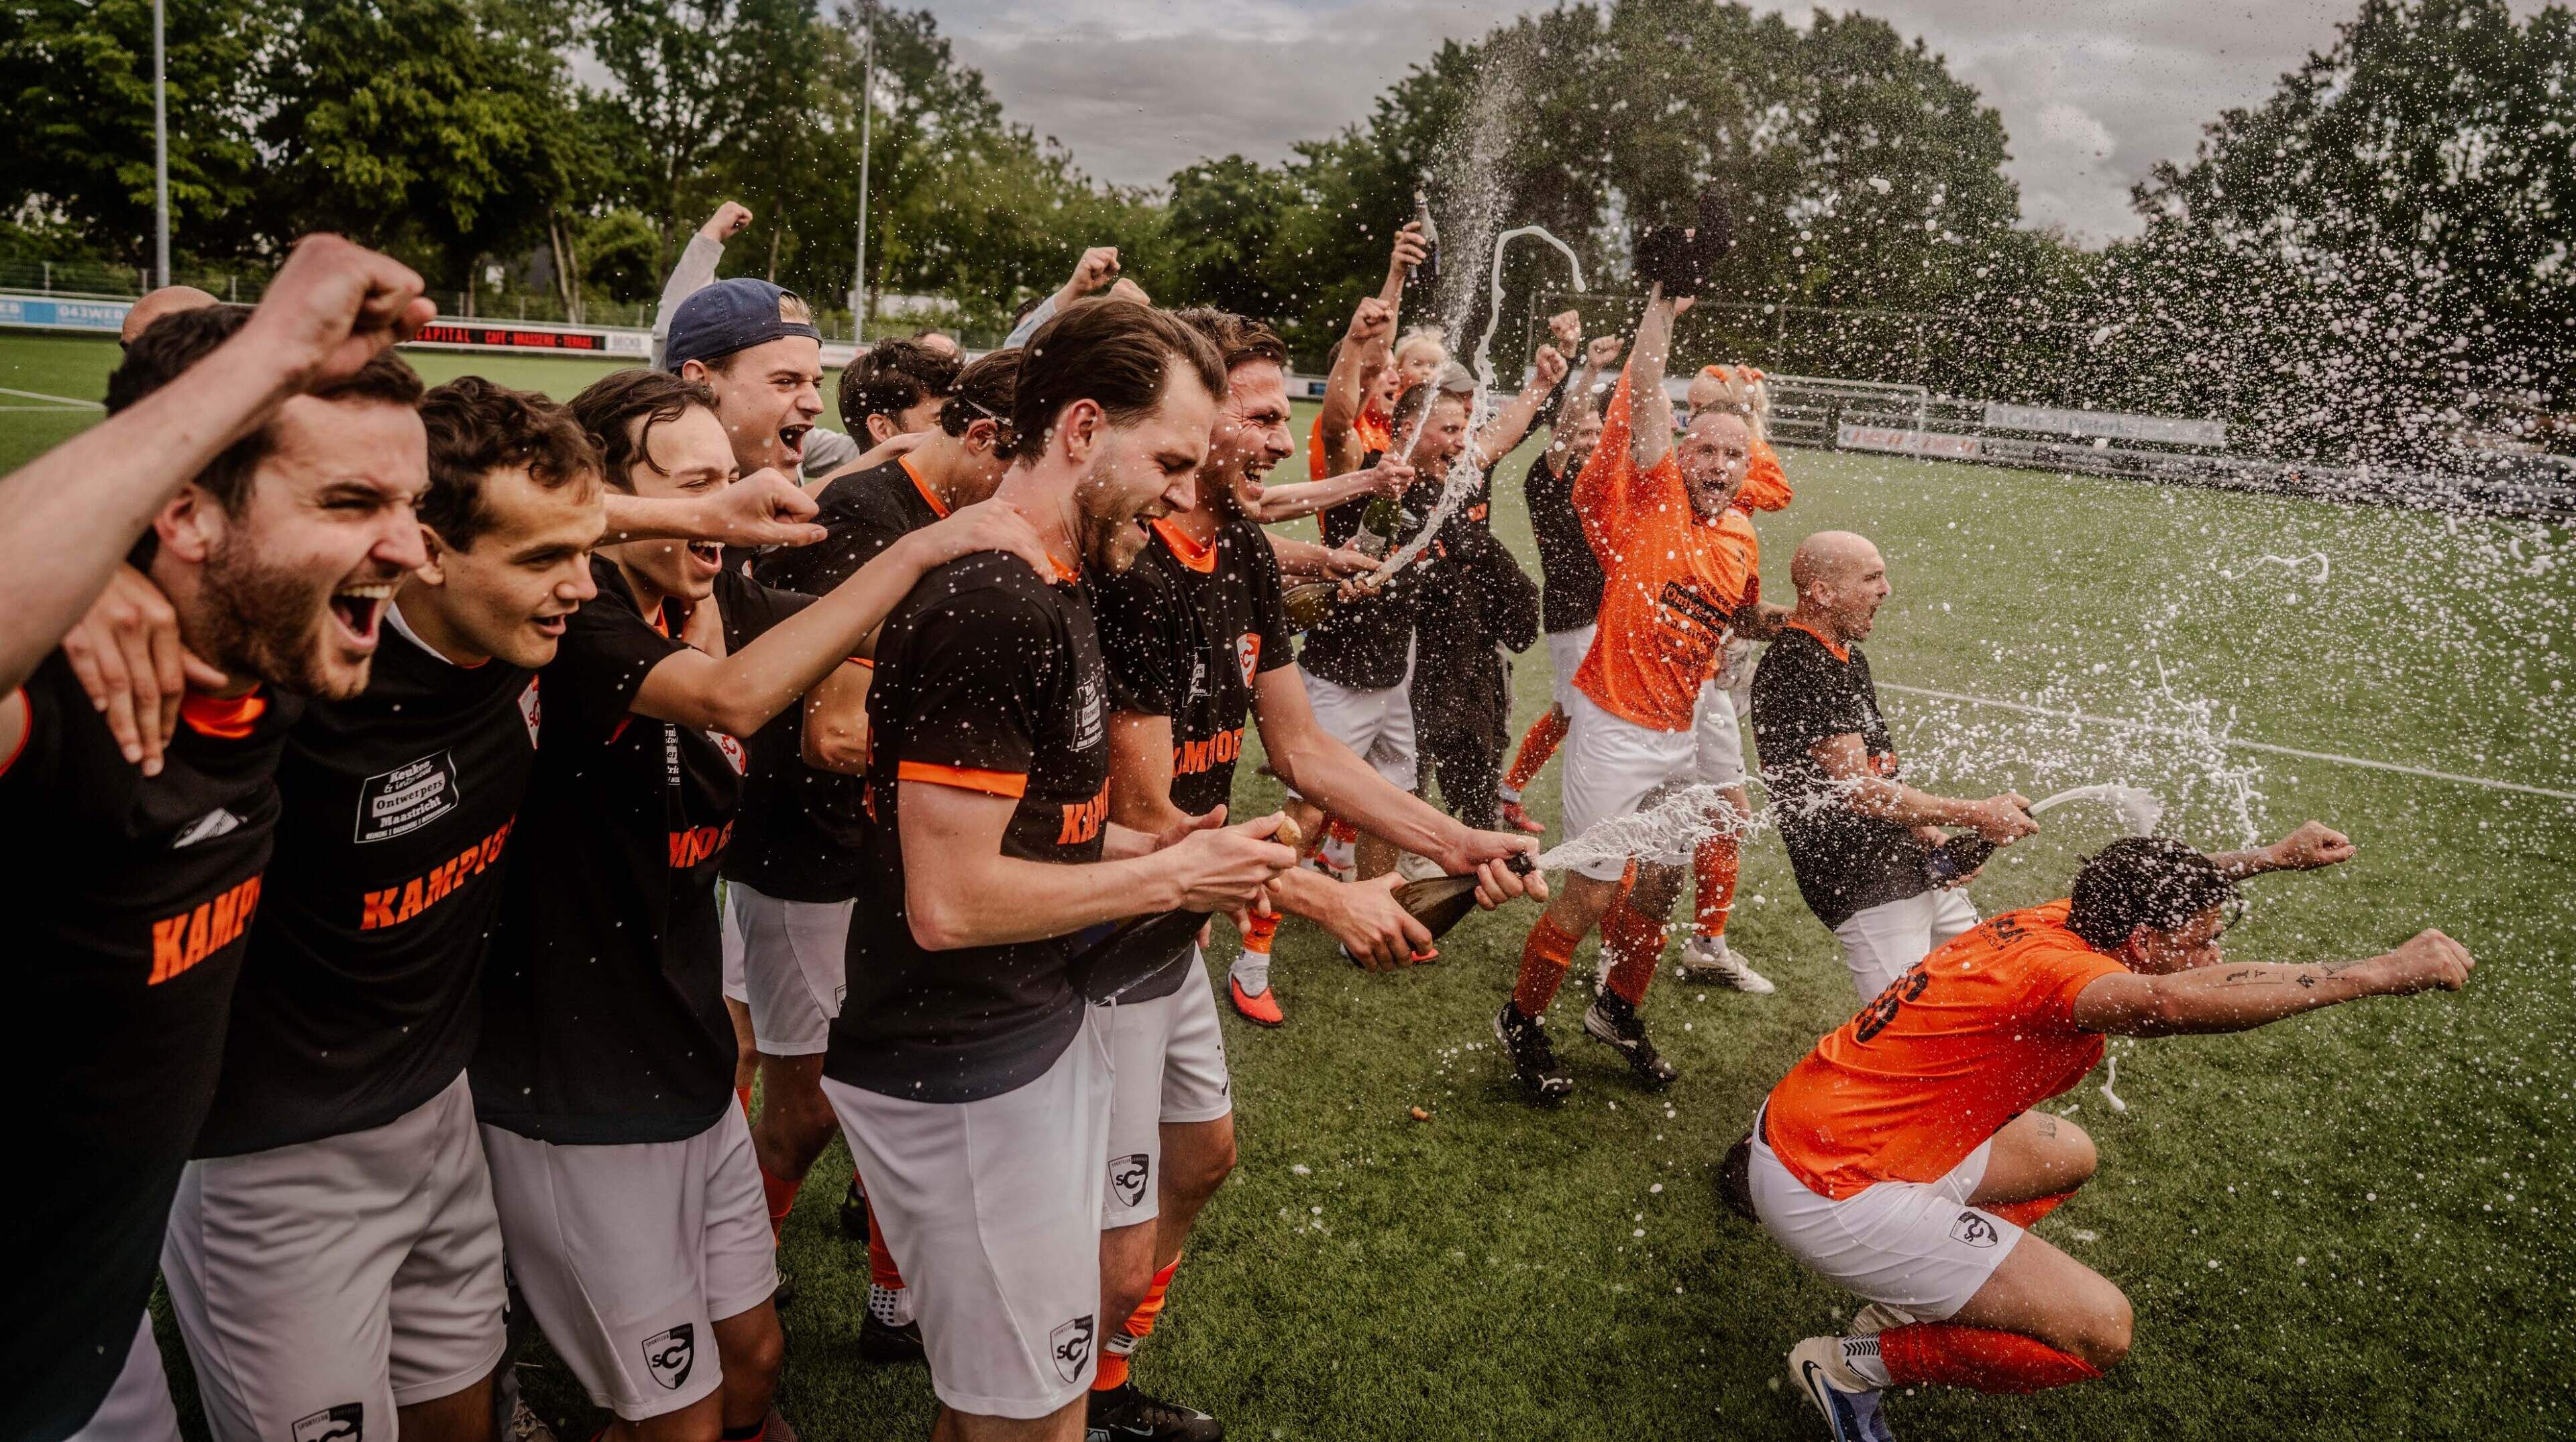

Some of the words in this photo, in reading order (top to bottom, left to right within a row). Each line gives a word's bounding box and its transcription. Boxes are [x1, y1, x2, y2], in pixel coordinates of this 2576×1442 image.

[389, 760, 431, 783] Keuken
[376, 779, 443, 810] Ontwerpers
[380, 794, 442, 828] Maastricht
[360, 811, 517, 931] KAMPIO
